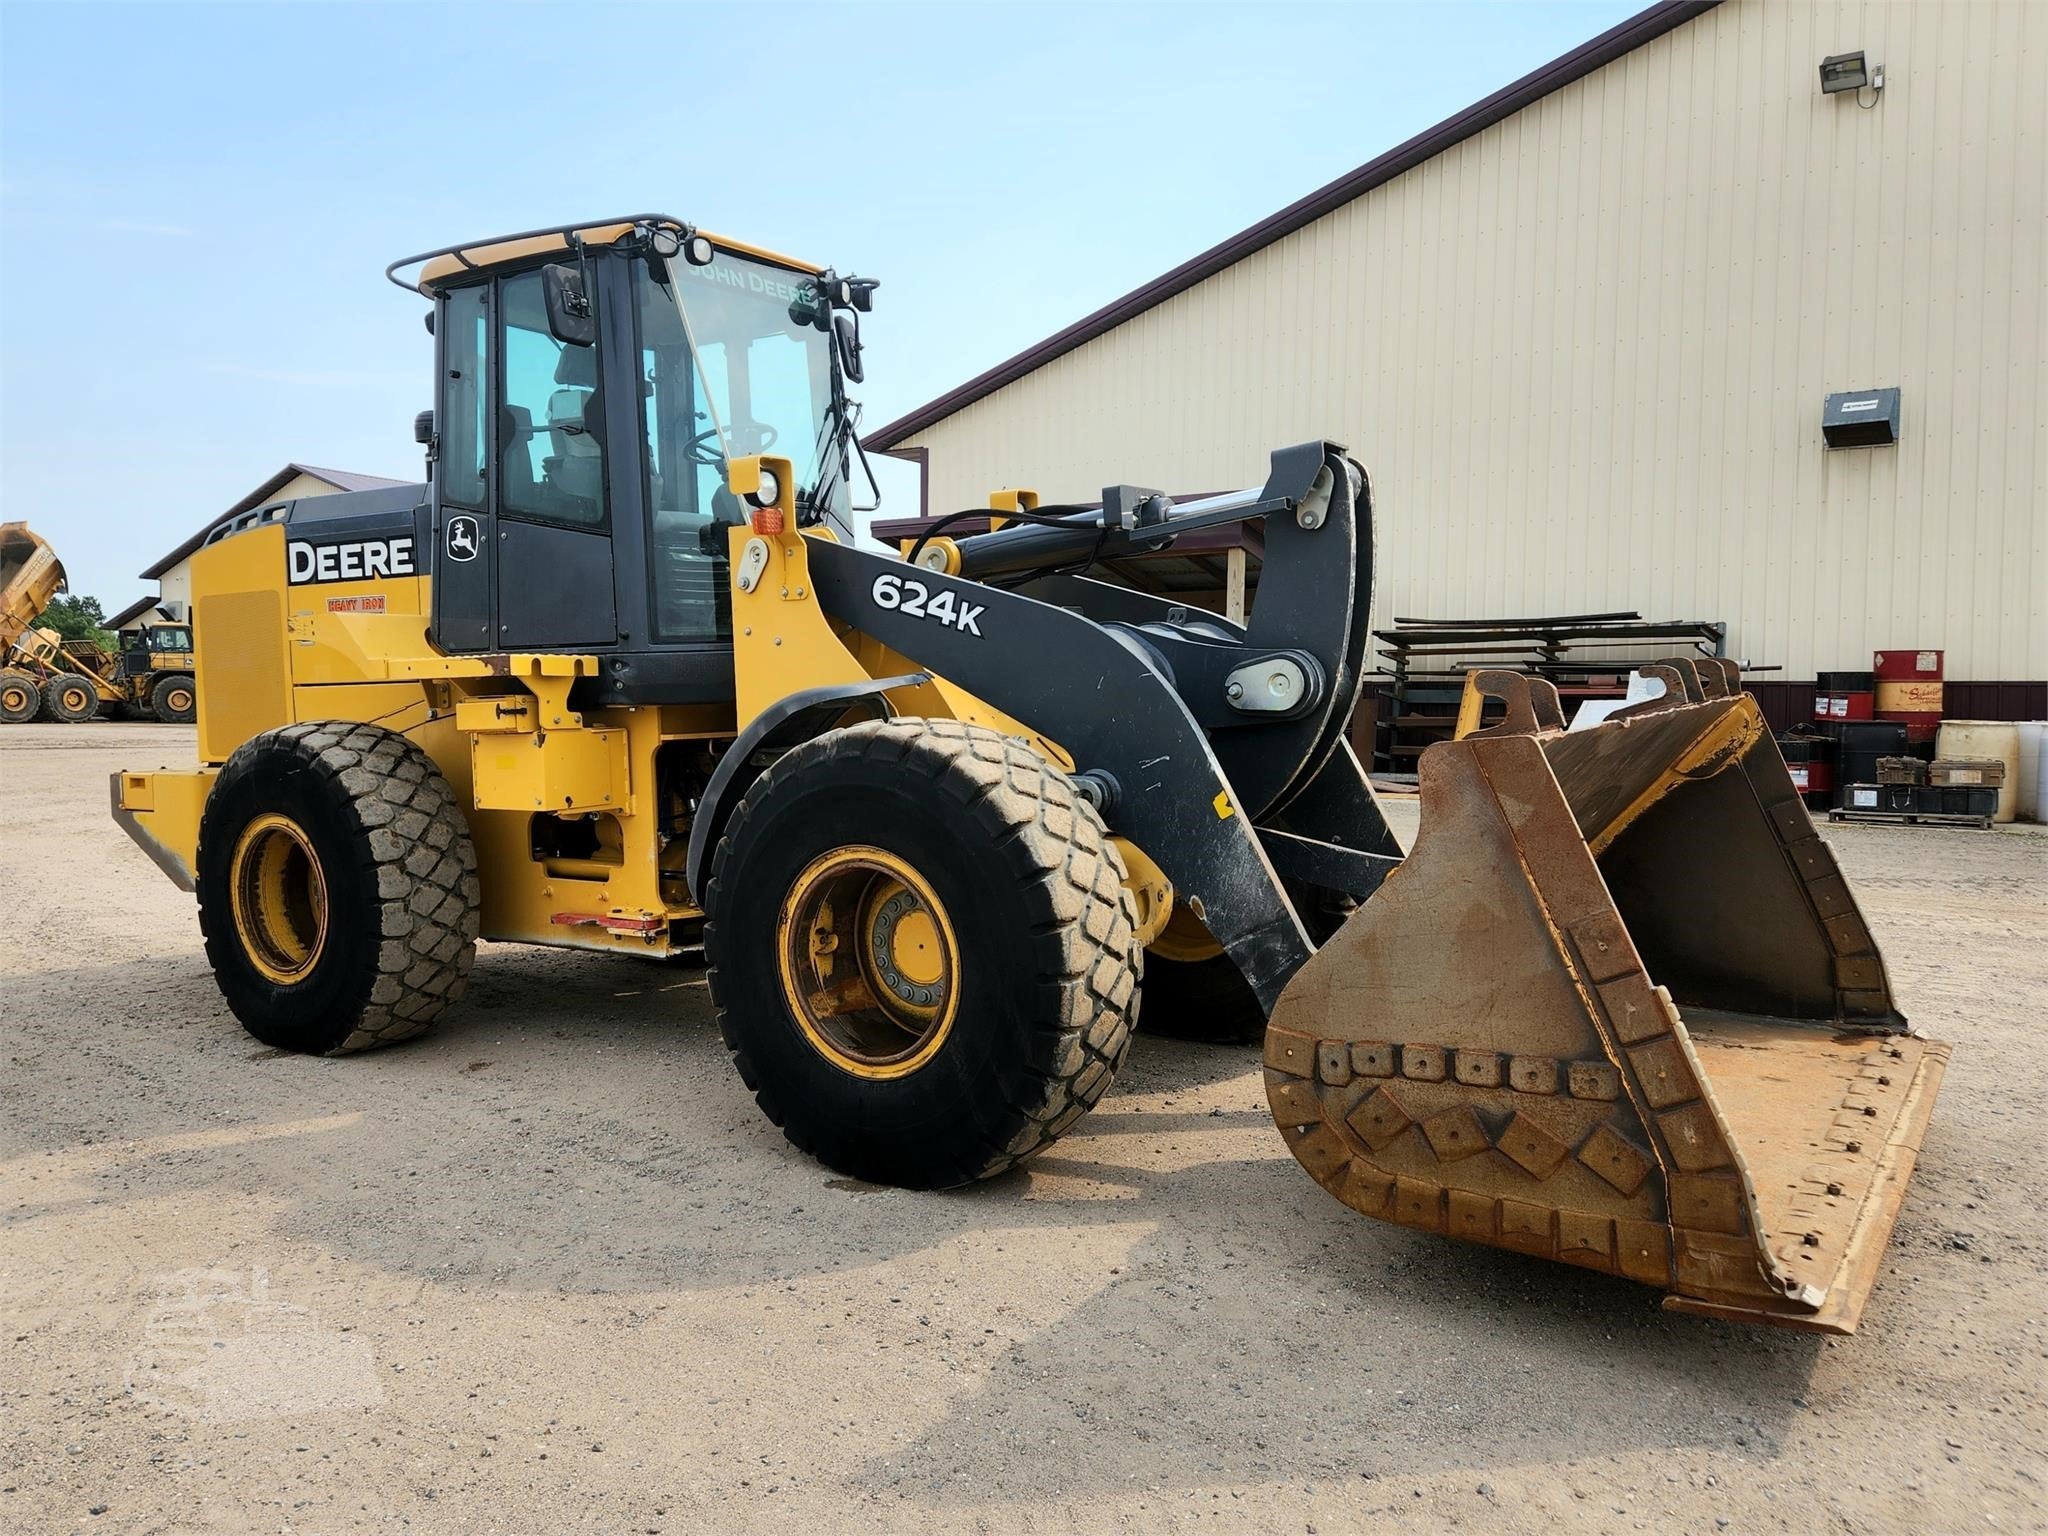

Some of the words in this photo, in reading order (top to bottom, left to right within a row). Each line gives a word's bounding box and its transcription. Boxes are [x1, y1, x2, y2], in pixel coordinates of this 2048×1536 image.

[688, 265, 745, 288] JOHN
[749, 271, 815, 307] DEERE
[288, 538, 414, 583] DEERE
[328, 599, 358, 612] HEAVY
[362, 597, 385, 610] IRON
[872, 574, 986, 637] 624K
